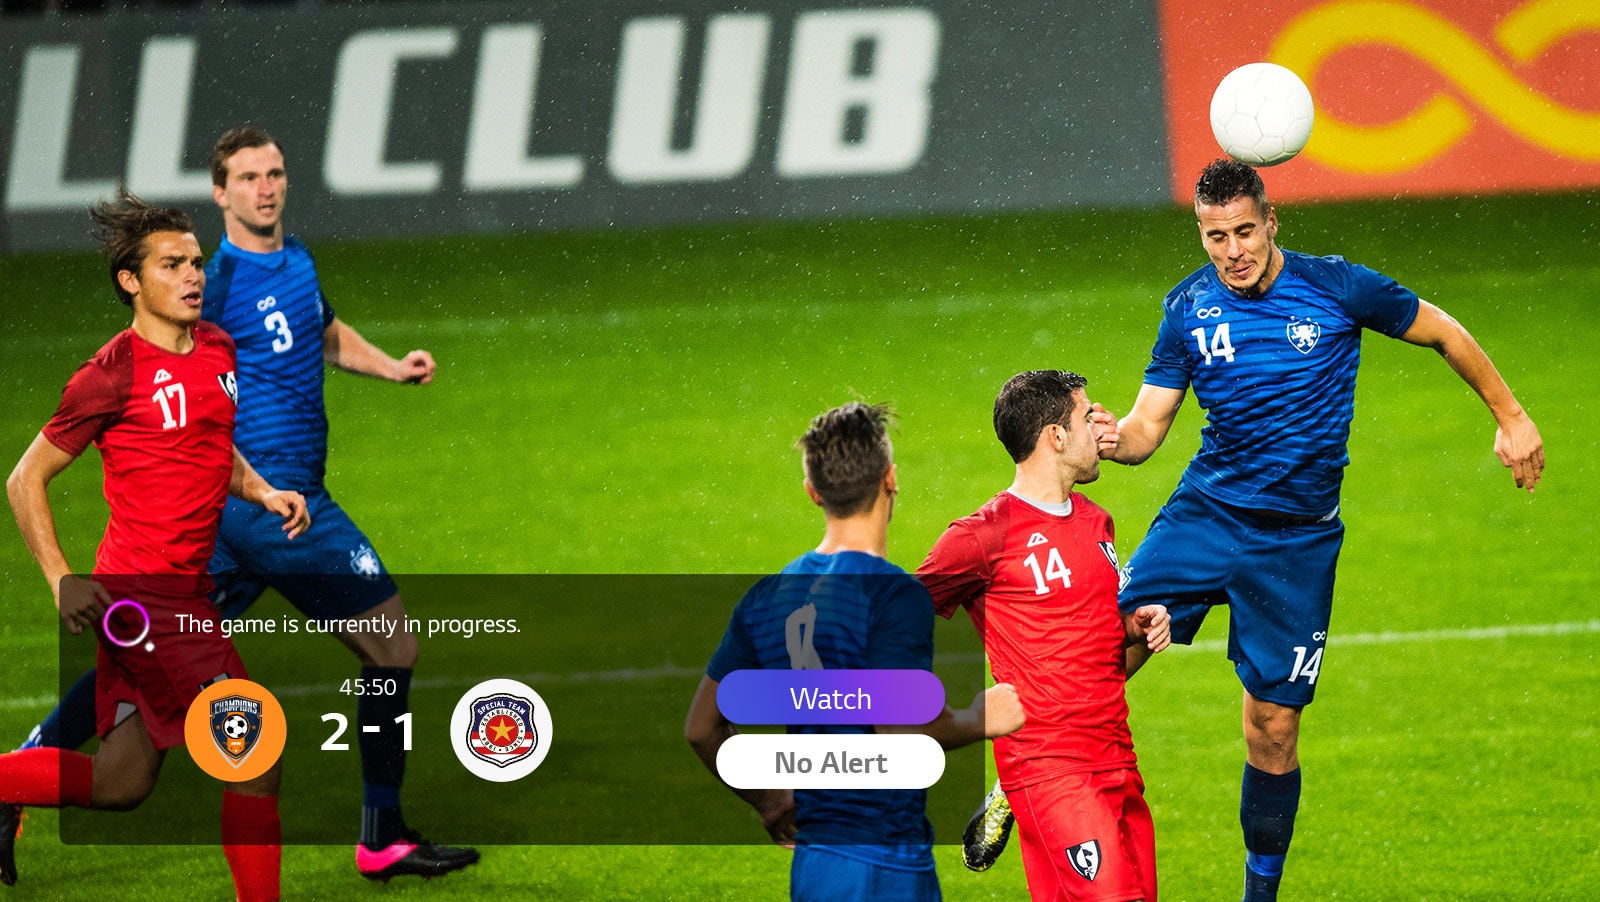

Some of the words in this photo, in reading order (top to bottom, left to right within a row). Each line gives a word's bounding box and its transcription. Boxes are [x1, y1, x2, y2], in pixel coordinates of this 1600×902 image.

[323, 8, 940, 196] CLUB
[264, 310, 294, 353] 3
[1191, 322, 1236, 366] 14
[151, 382, 187, 430] 17
[1023, 547, 1072, 595] 14
[1287, 645, 1324, 685] 14
